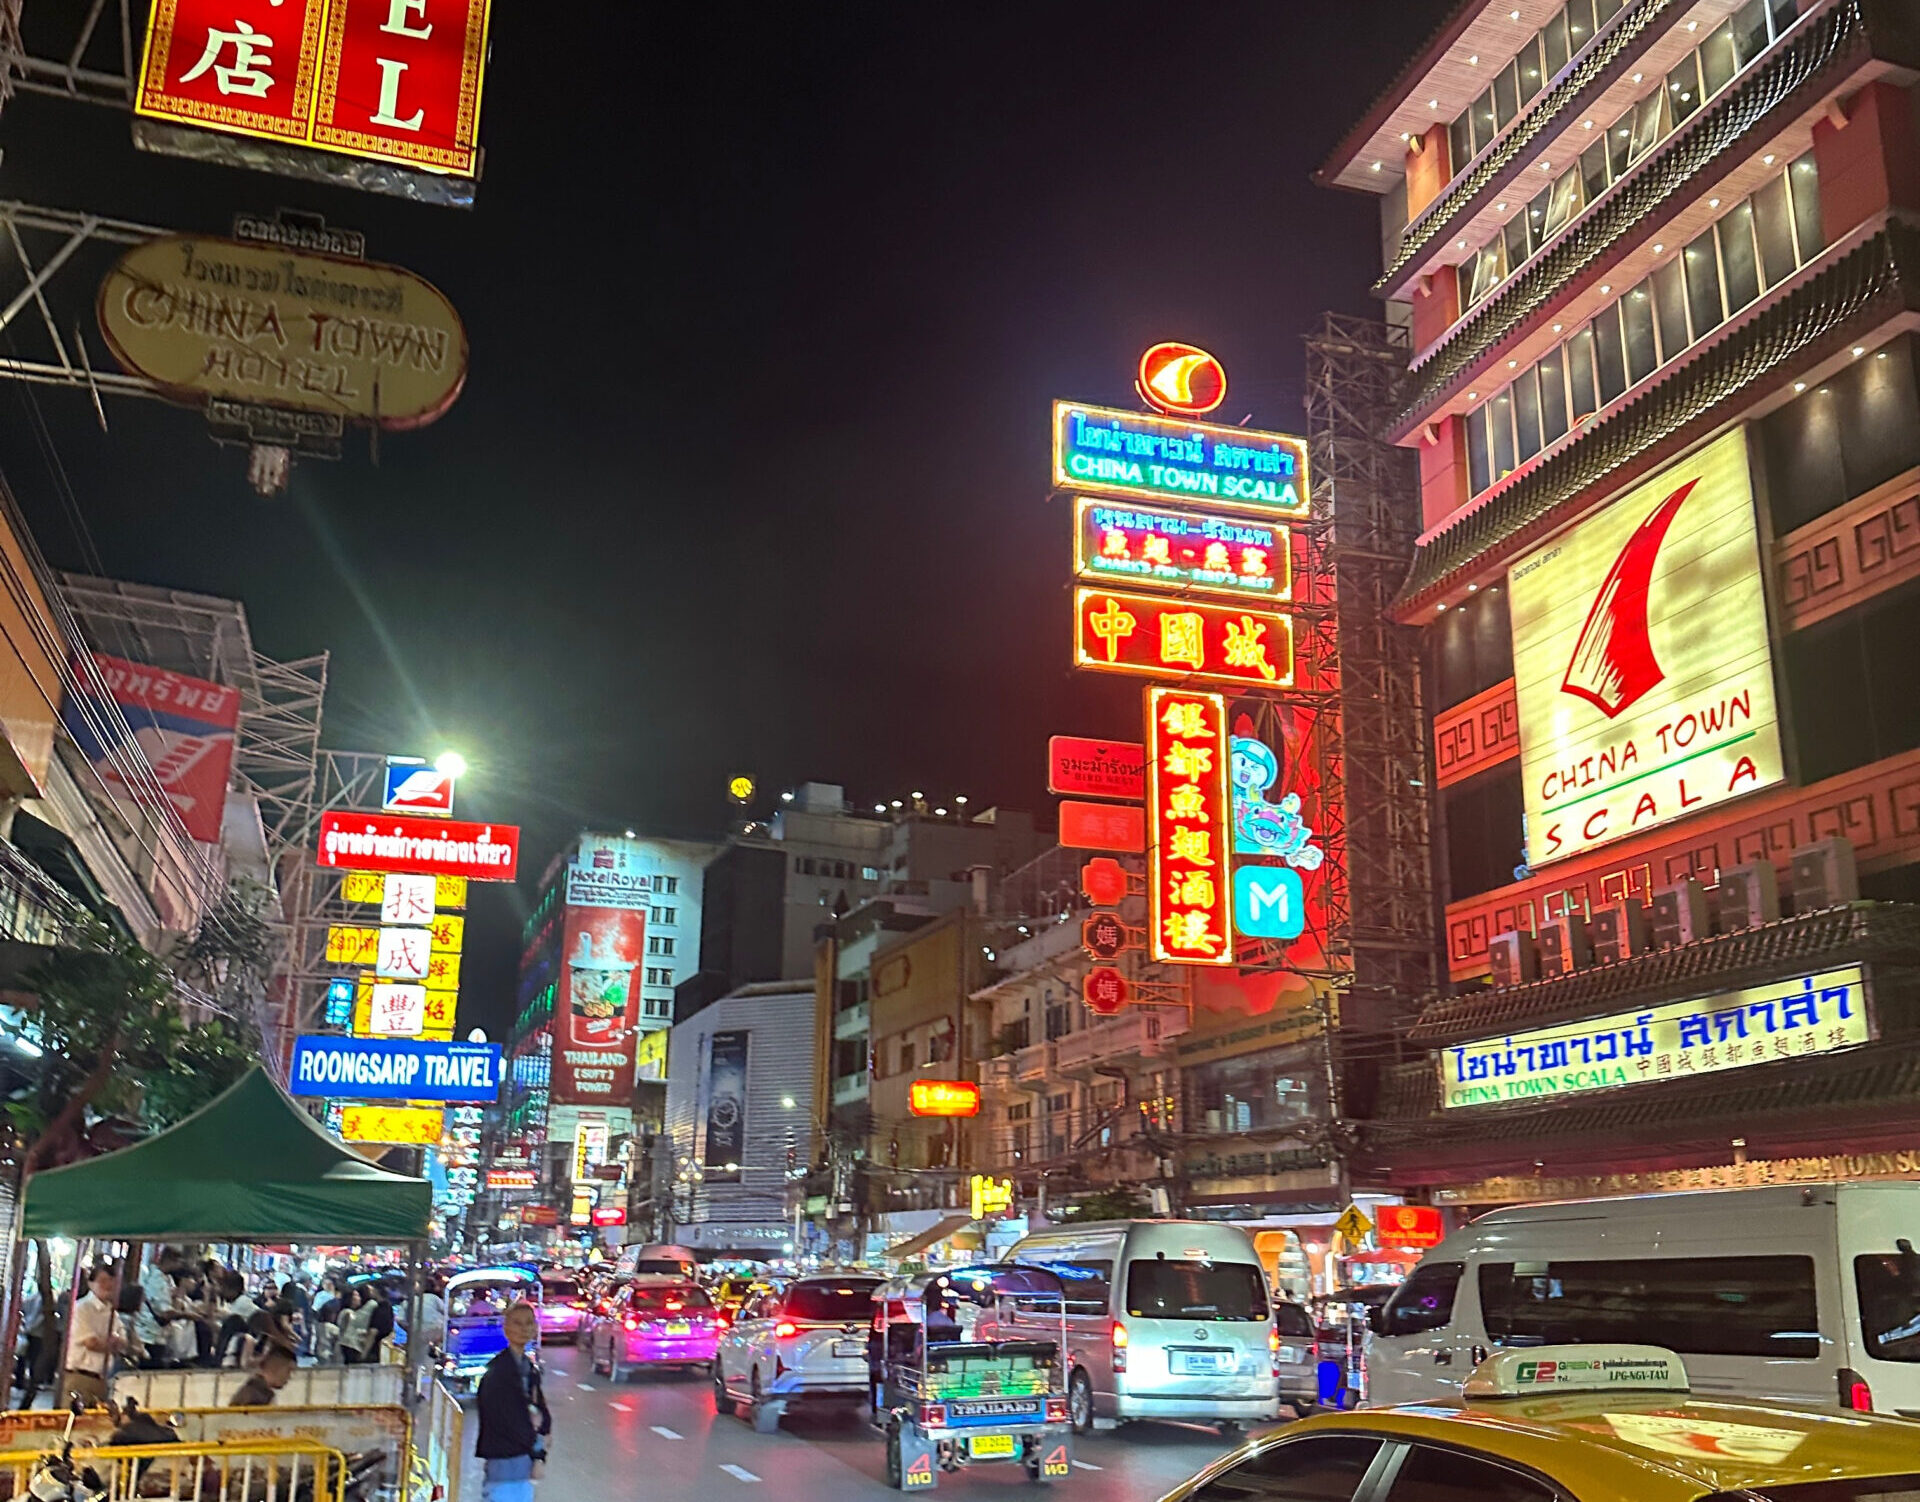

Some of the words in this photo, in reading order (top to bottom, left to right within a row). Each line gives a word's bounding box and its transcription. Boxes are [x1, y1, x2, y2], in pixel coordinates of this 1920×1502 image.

[179, 0, 283, 98] 店
[123, 284, 290, 350] CHINA
[307, 312, 449, 372] TOWN
[203, 347, 360, 398] HOTEL
[1070, 453, 1144, 483] CHINA
[1149, 465, 1219, 494] TOWN
[1222, 475, 1299, 505] SCALA
[1089, 598, 1276, 680] 中國城
[1542, 739, 1639, 801] CHINA
[1656, 688, 1753, 754] TOWN
[1160, 702, 1223, 954] 銀都魚翅酒樓
[1545, 756, 1758, 855] SCALA
[299, 1050, 420, 1085] ROONGSARP
[424, 1055, 493, 1087] TRAVEL
[563, 1051, 628, 1066] THAILAND
[1451, 1083, 1501, 1106] CHINA
[1506, 1075, 1559, 1098] TOWN
[1563, 1065, 1628, 1091] SCALA
[1516, 1361, 1557, 1383] G2
[1609, 1370, 1669, 1381] LPG-NGV-TAXI
[954, 1401, 1037, 1415] THAILAND
